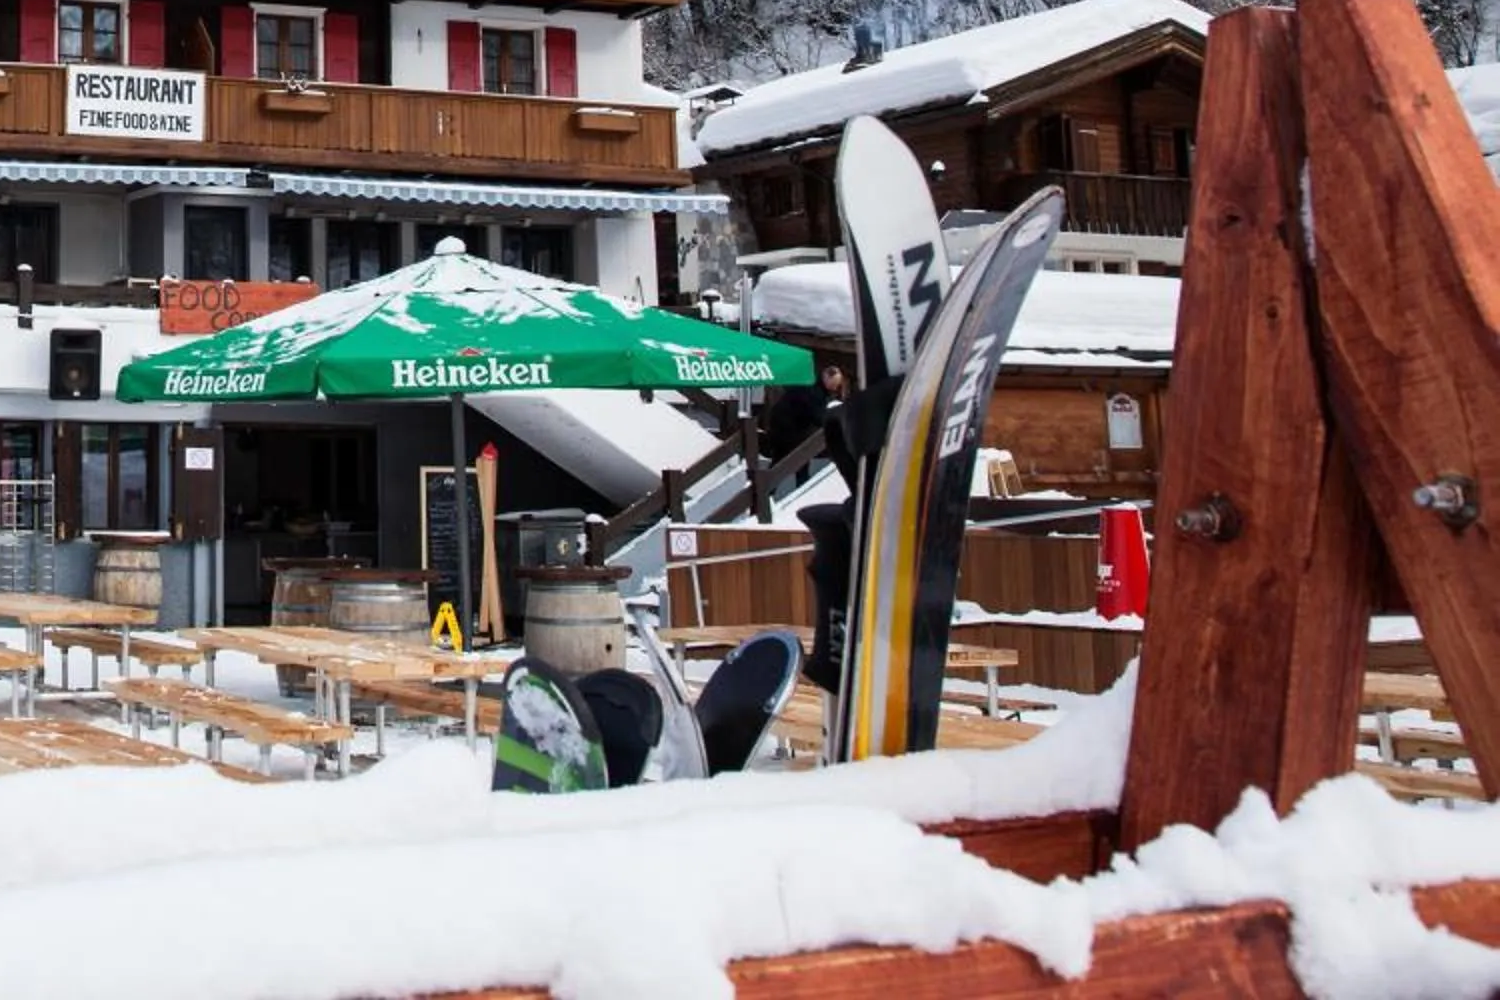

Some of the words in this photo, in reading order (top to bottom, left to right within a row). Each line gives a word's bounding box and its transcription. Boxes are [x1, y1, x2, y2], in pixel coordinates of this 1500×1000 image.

[75, 73, 197, 105] RESTAURANT
[79, 109, 113, 129] FINE
[114, 111, 148, 130] FOOD
[163, 282, 240, 311] FOOD
[163, 369, 266, 395] Heineken
[391, 358, 552, 388] Heineken
[674, 355, 774, 382] Heineken
[938, 333, 997, 459] ELAN
